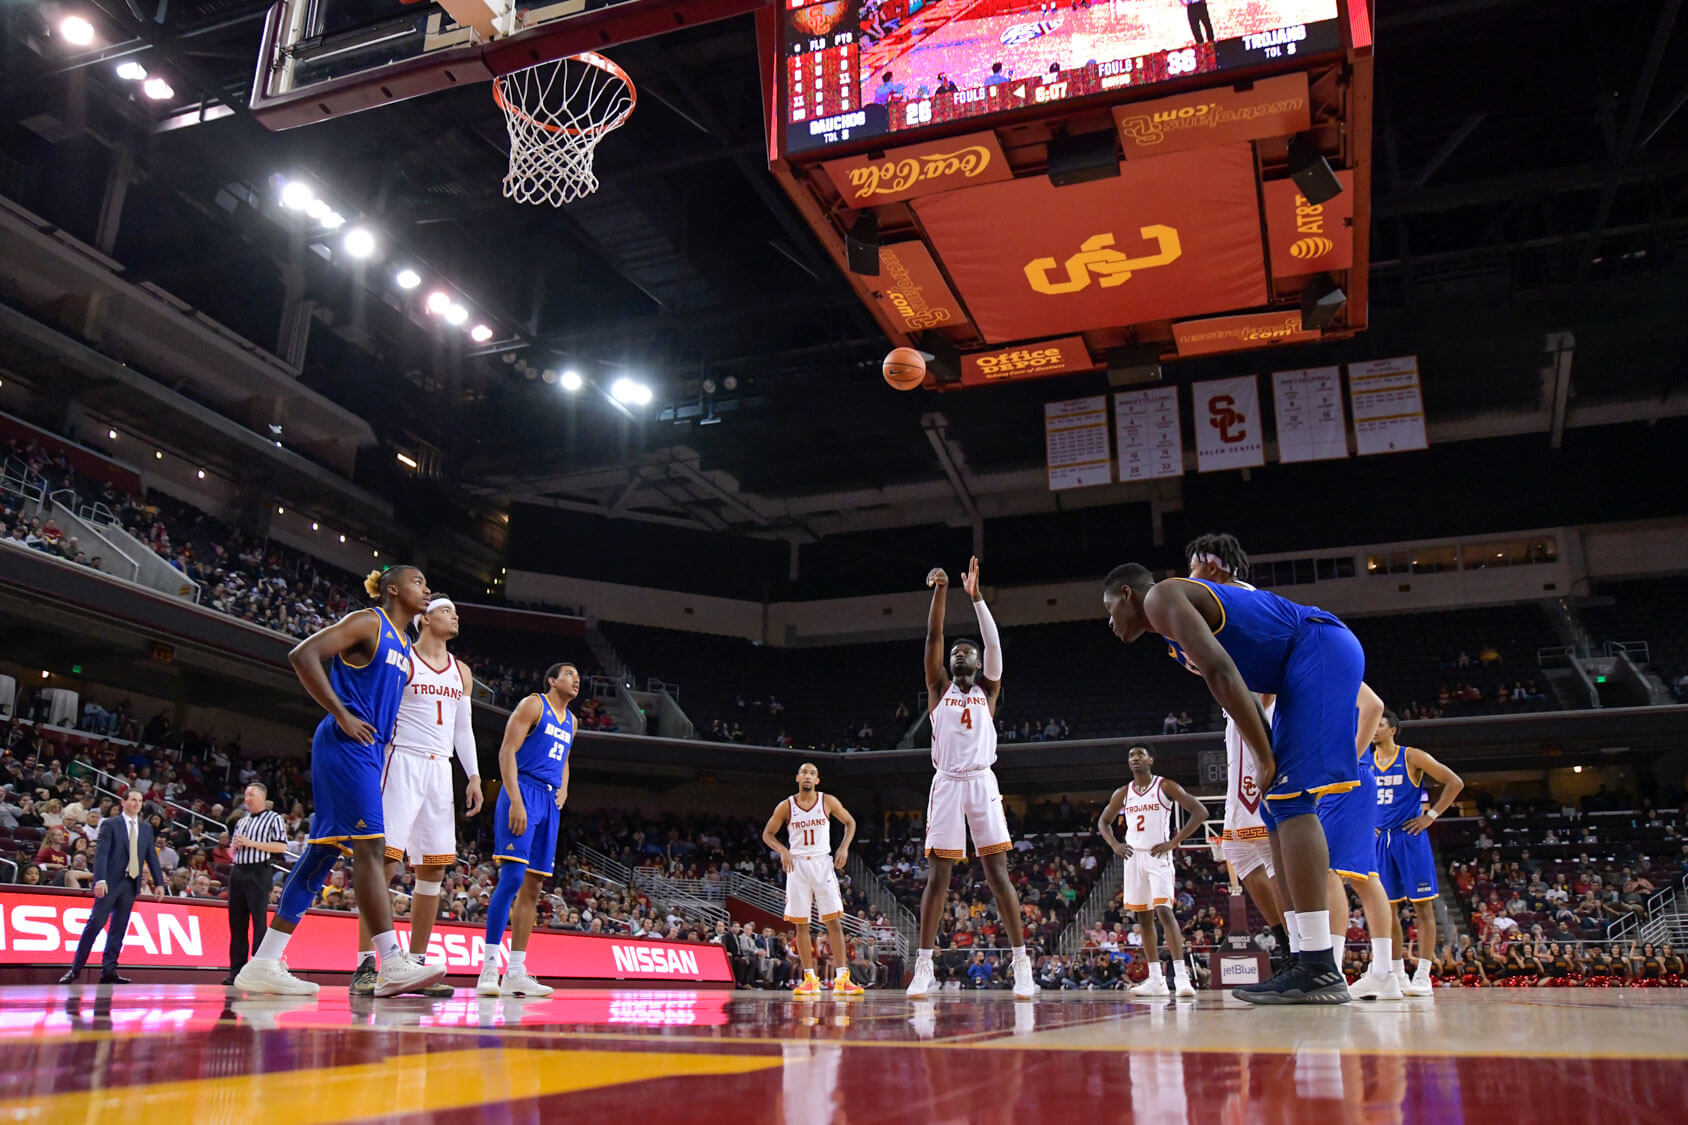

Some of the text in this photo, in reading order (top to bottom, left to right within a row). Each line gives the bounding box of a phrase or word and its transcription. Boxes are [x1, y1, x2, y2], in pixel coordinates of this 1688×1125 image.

[1242, 25, 1307, 51] TROJANS
[1264, 47, 1282, 59] TOL
[1098, 59, 1133, 78] FOULS
[953, 88, 986, 104] FOULS
[1035, 82, 1068, 103] 6:07
[1153, 103, 1217, 123] .com
[1243, 329, 1293, 342] .com
[976, 348, 1061, 367] Office
[981, 356, 1063, 374] DEPOT
[1208, 394, 1247, 444] SC
[411, 683, 463, 701] TROJANS
[944, 697, 986, 708] TROANS
[436, 700, 443, 726] 1
[961, 708, 972, 730] 4
[549, 741, 565, 761] 23
[1243, 775, 1257, 797] SC
[1375, 774, 1404, 787] CSB
[1376, 788, 1394, 805] 55
[1126, 803, 1160, 814] TROJANS
[791, 818, 826, 830] TROJANS
[1136, 815, 1145, 832] 2
[803, 829, 816, 846] 11
[612, 945, 699, 975] NISSAN
[1223, 964, 1257, 977] jetBlue
